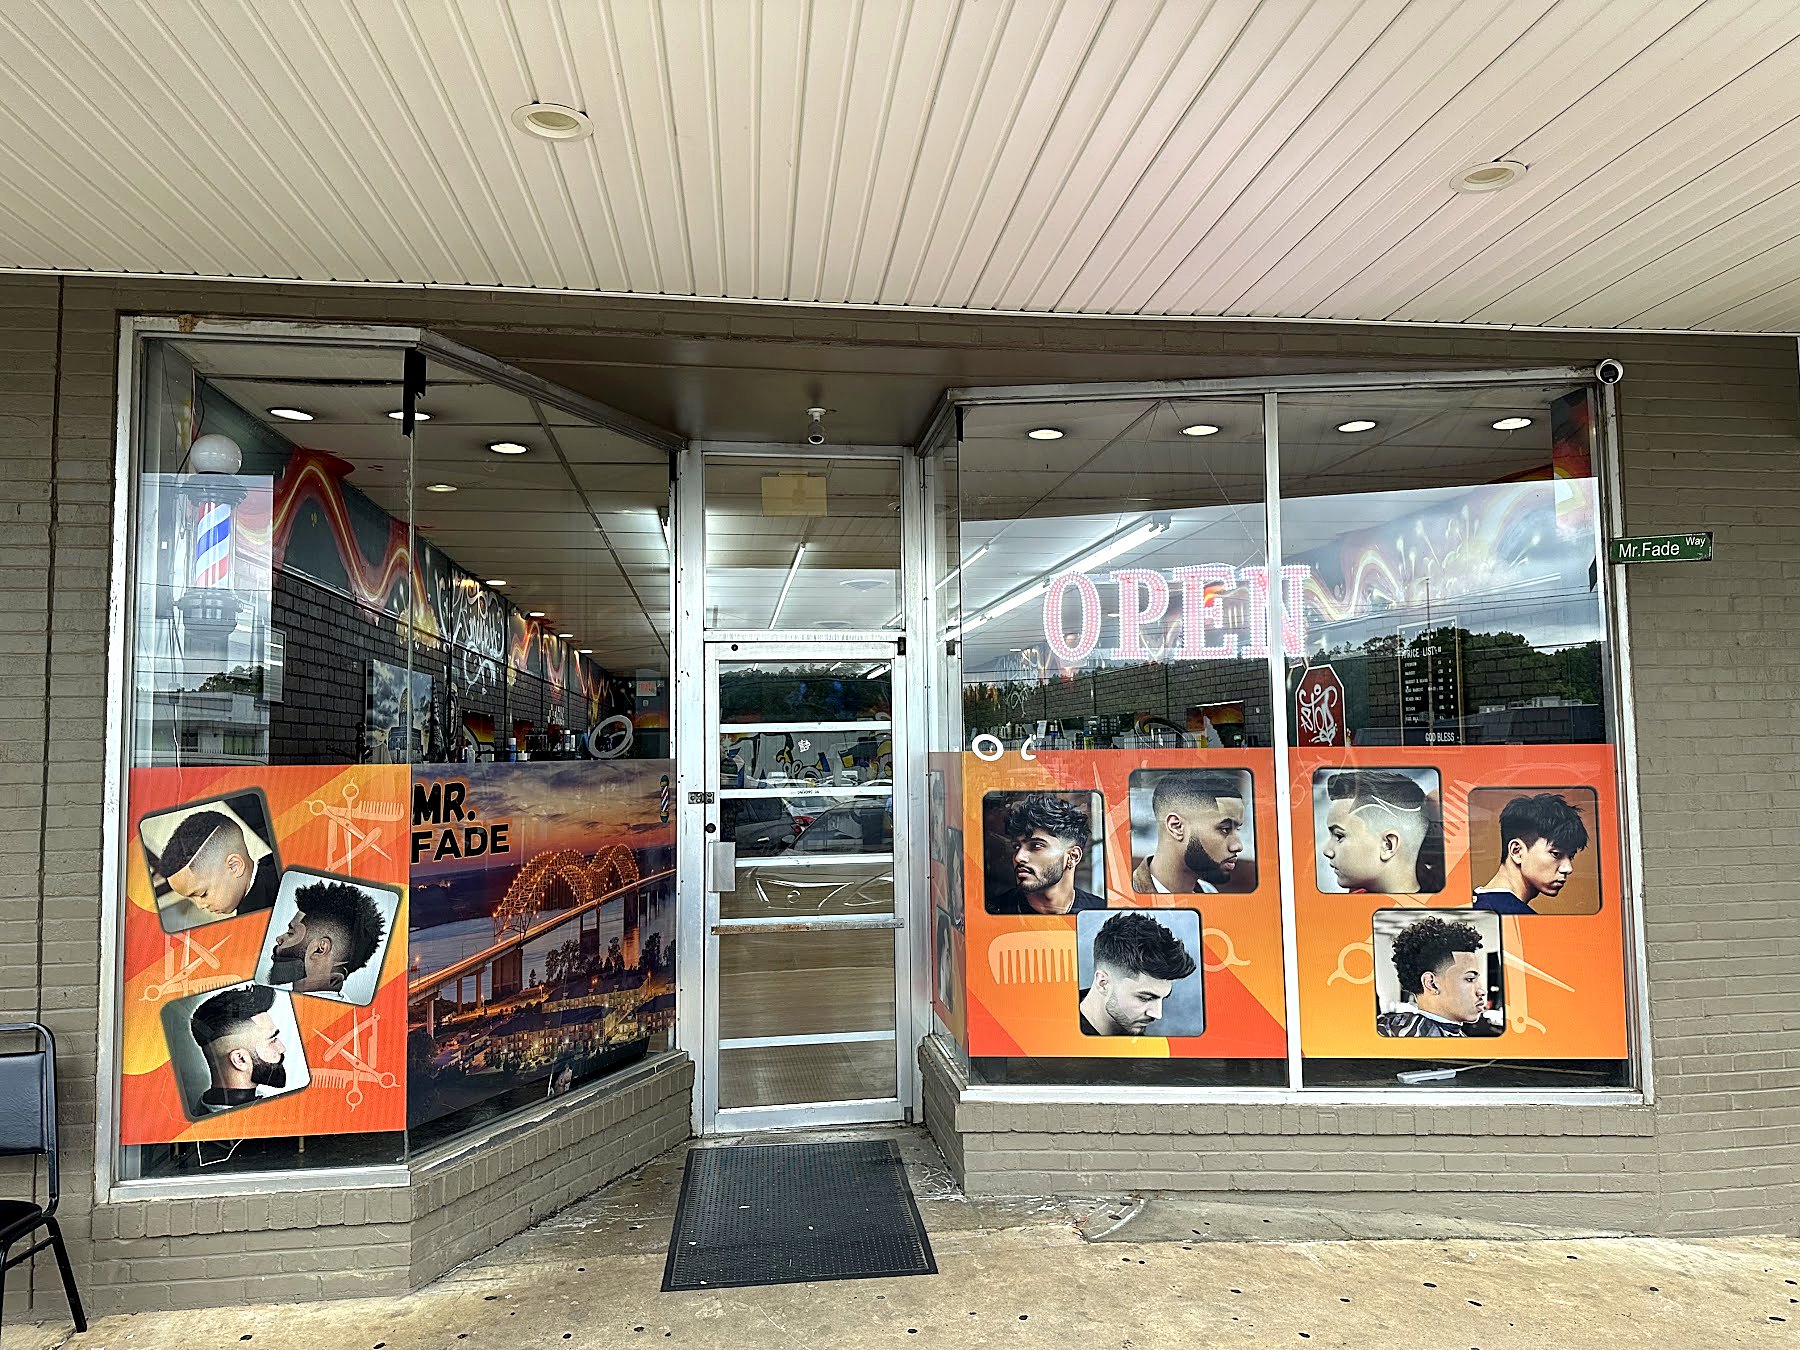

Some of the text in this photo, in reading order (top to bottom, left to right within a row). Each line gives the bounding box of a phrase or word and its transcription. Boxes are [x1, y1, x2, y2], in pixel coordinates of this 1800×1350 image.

[1685, 536, 1706, 547] Way
[1042, 563, 1311, 662] OPEN
[1425, 732, 1455, 742] GOD BLESS
[412, 782, 476, 826] MR.
[411, 823, 510, 863] FADE
